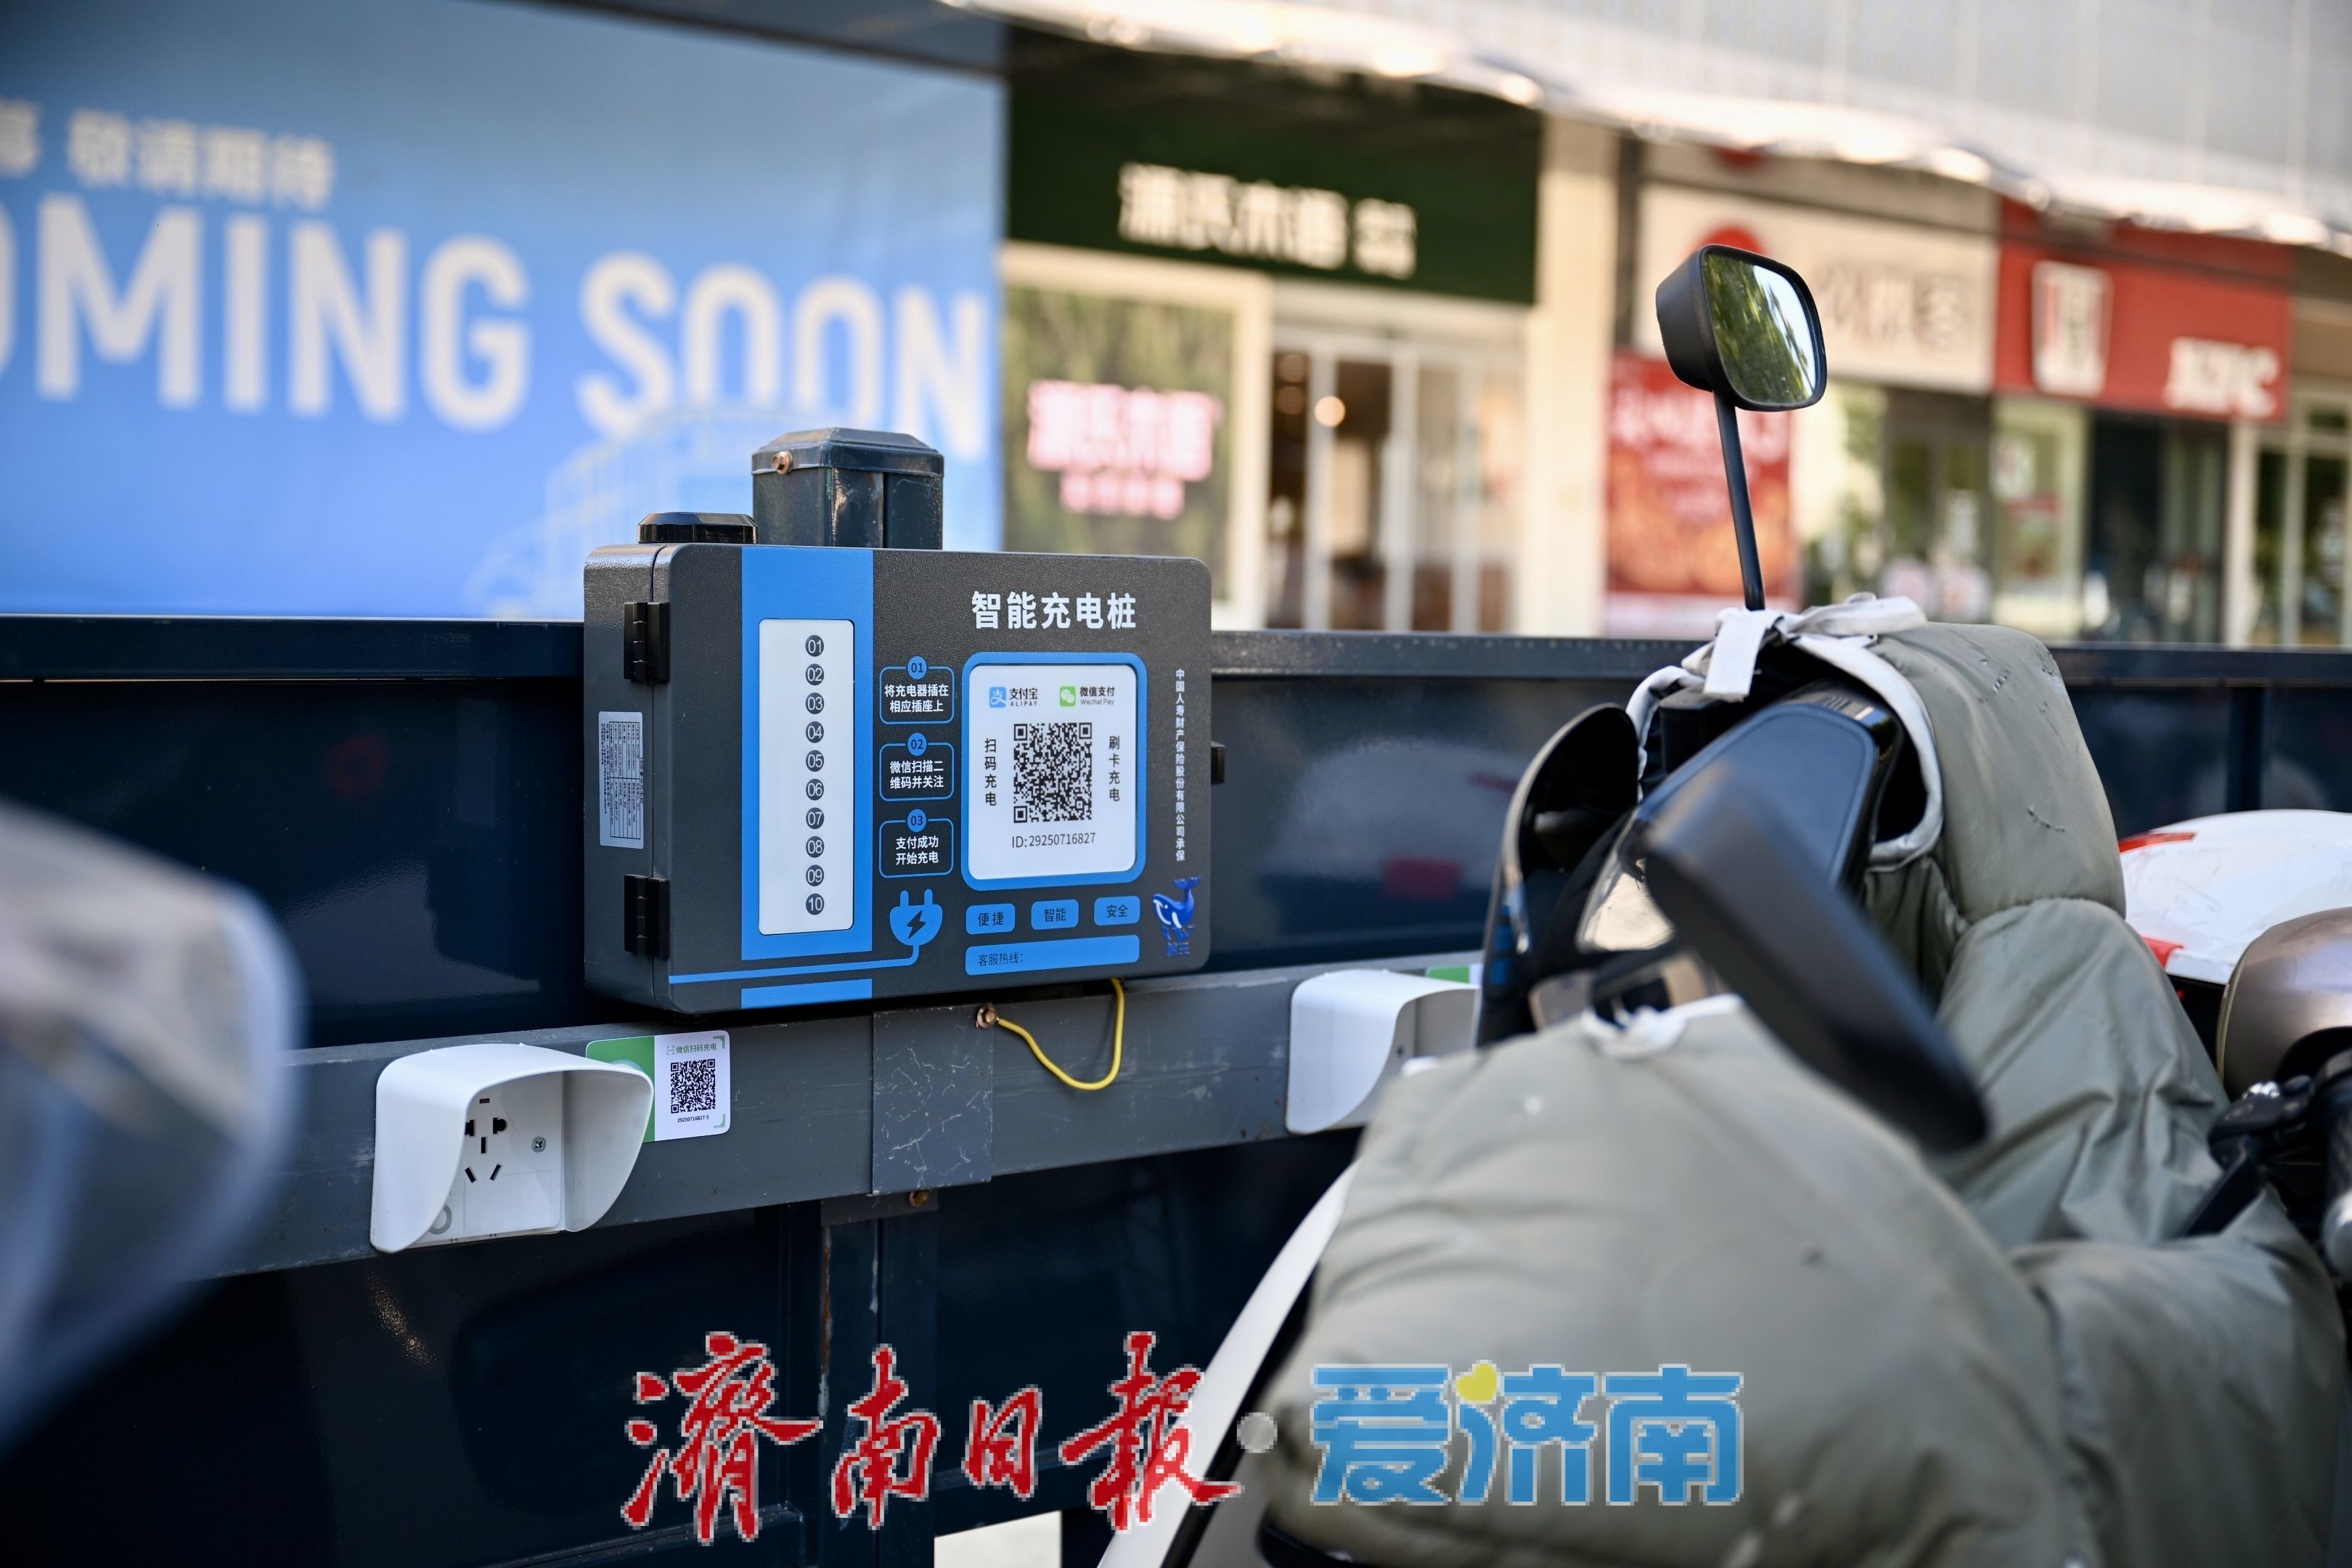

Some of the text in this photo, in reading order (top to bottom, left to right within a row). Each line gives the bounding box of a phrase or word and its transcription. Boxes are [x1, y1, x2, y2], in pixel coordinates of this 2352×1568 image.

[0, 190, 989, 462] MING SOON
[971, 590, 1136, 629] 智能充电桩
[807, 639, 822, 653] 01
[807, 668, 822, 682] 02
[910, 662, 924, 674] 01
[883, 683, 950, 698] 将充电器插在
[1009, 687, 1038, 700] 支付宝
[1079, 686, 1115, 697] 微信支付
[807, 696, 822, 711] 03
[889, 699, 944, 713] 相应插座上
[807, 725, 822, 740] 04
[910, 739, 924, 751] 02
[807, 754, 822, 768] 05
[889, 759, 944, 774] 微信扫描二
[1175, 668, 1185, 862] 中国人寿财产保险股份有限公司承保
[984, 738, 997, 807] 扫码充电
[1108, 735, 1120, 802] 刷卡充电
[889, 775, 944, 790] 维码并关注
[807, 783, 822, 797] 06
[807, 812, 822, 826] 07
[910, 815, 924, 827] 03
[807, 840, 822, 854] 08
[895, 836, 939, 850] 支付成功
[1012, 832, 1096, 849] ID:29250716827
[895, 851, 939, 865] 开始充电
[807, 868, 822, 883] 09
[807, 897, 822, 912] 10
[1106, 904, 1128, 918] 安全
[978, 911, 1004, 927] 便捷
[1044, 907, 1066, 923] 智能
[676, 1043, 717, 1054] 微信扫码充电
